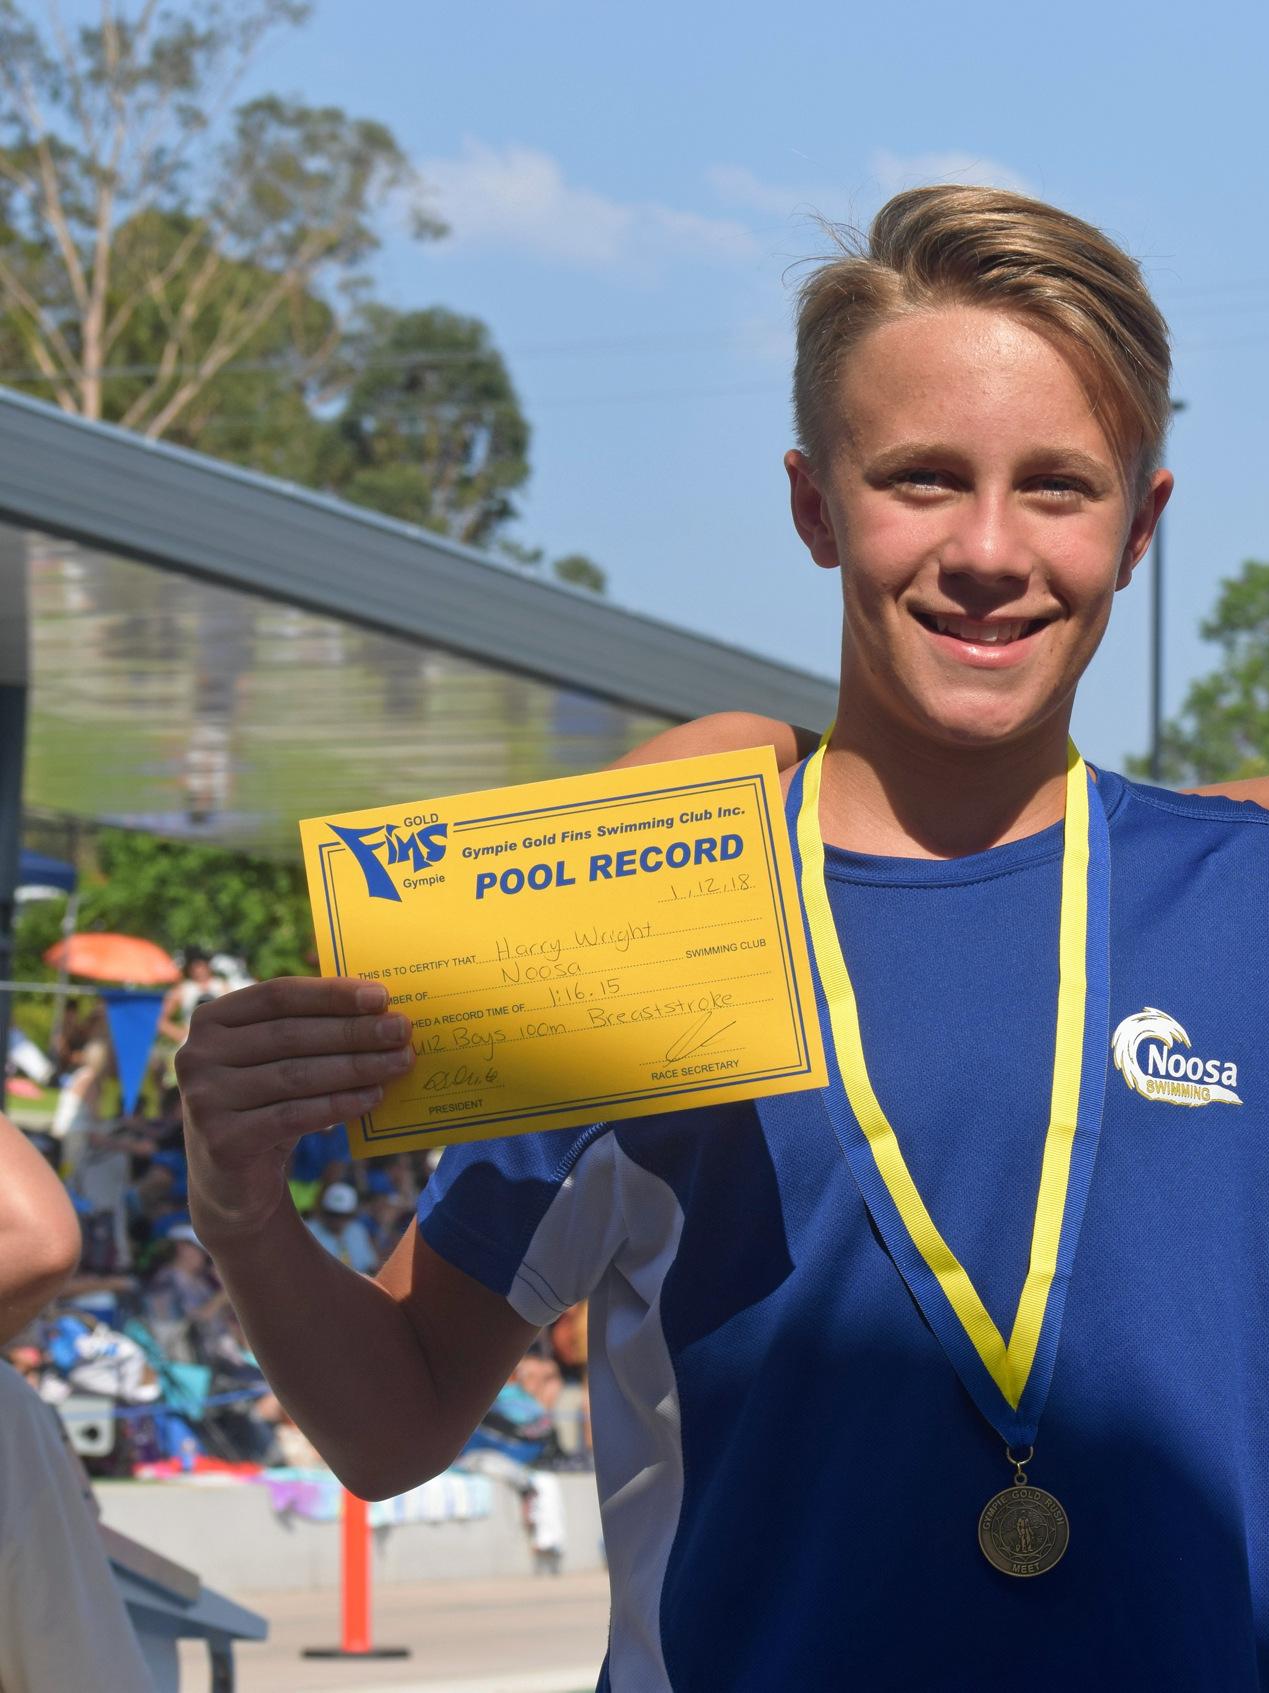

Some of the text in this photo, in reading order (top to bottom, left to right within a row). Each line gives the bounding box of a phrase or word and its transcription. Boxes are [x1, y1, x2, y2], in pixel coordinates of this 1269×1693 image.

[403, 813, 439, 828] GOLD
[462, 806, 746, 860] Gympie Gold Fins Swimming Club Inc.
[475, 834, 744, 900] POOL RECORD
[403, 874, 446, 890] Gympie
[496, 920, 653, 962] Harry Wright
[685, 938, 767, 960] SWIMMING CLUB
[358, 955, 477, 981] THIS IS TO CERTIFY THAT
[501, 960, 582, 983] Noosa
[415, 992, 428, 1001] OF
[433, 1017, 442, 1026] A
[442, 1011, 484, 1024] RECORD
[485, 1006, 509, 1018] TIME
[511, 1003, 525, 1013] OF
[452, 1027, 506, 1061] Boys
[520, 1022, 566, 1039] 100m
[588, 991, 734, 1027] Breaststroke
[651, 1059, 740, 1081] RACE SECRETARY
[1148, 1044, 1238, 1087] Noosa
[1146, 1080, 1211, 1102] SWIMMING
[428, 1100, 484, 1115] PRESIDENT
[983, 1490, 1065, 1530] GYMPIE GOLD RUSH
[1012, 1563, 1040, 1574] MEET
